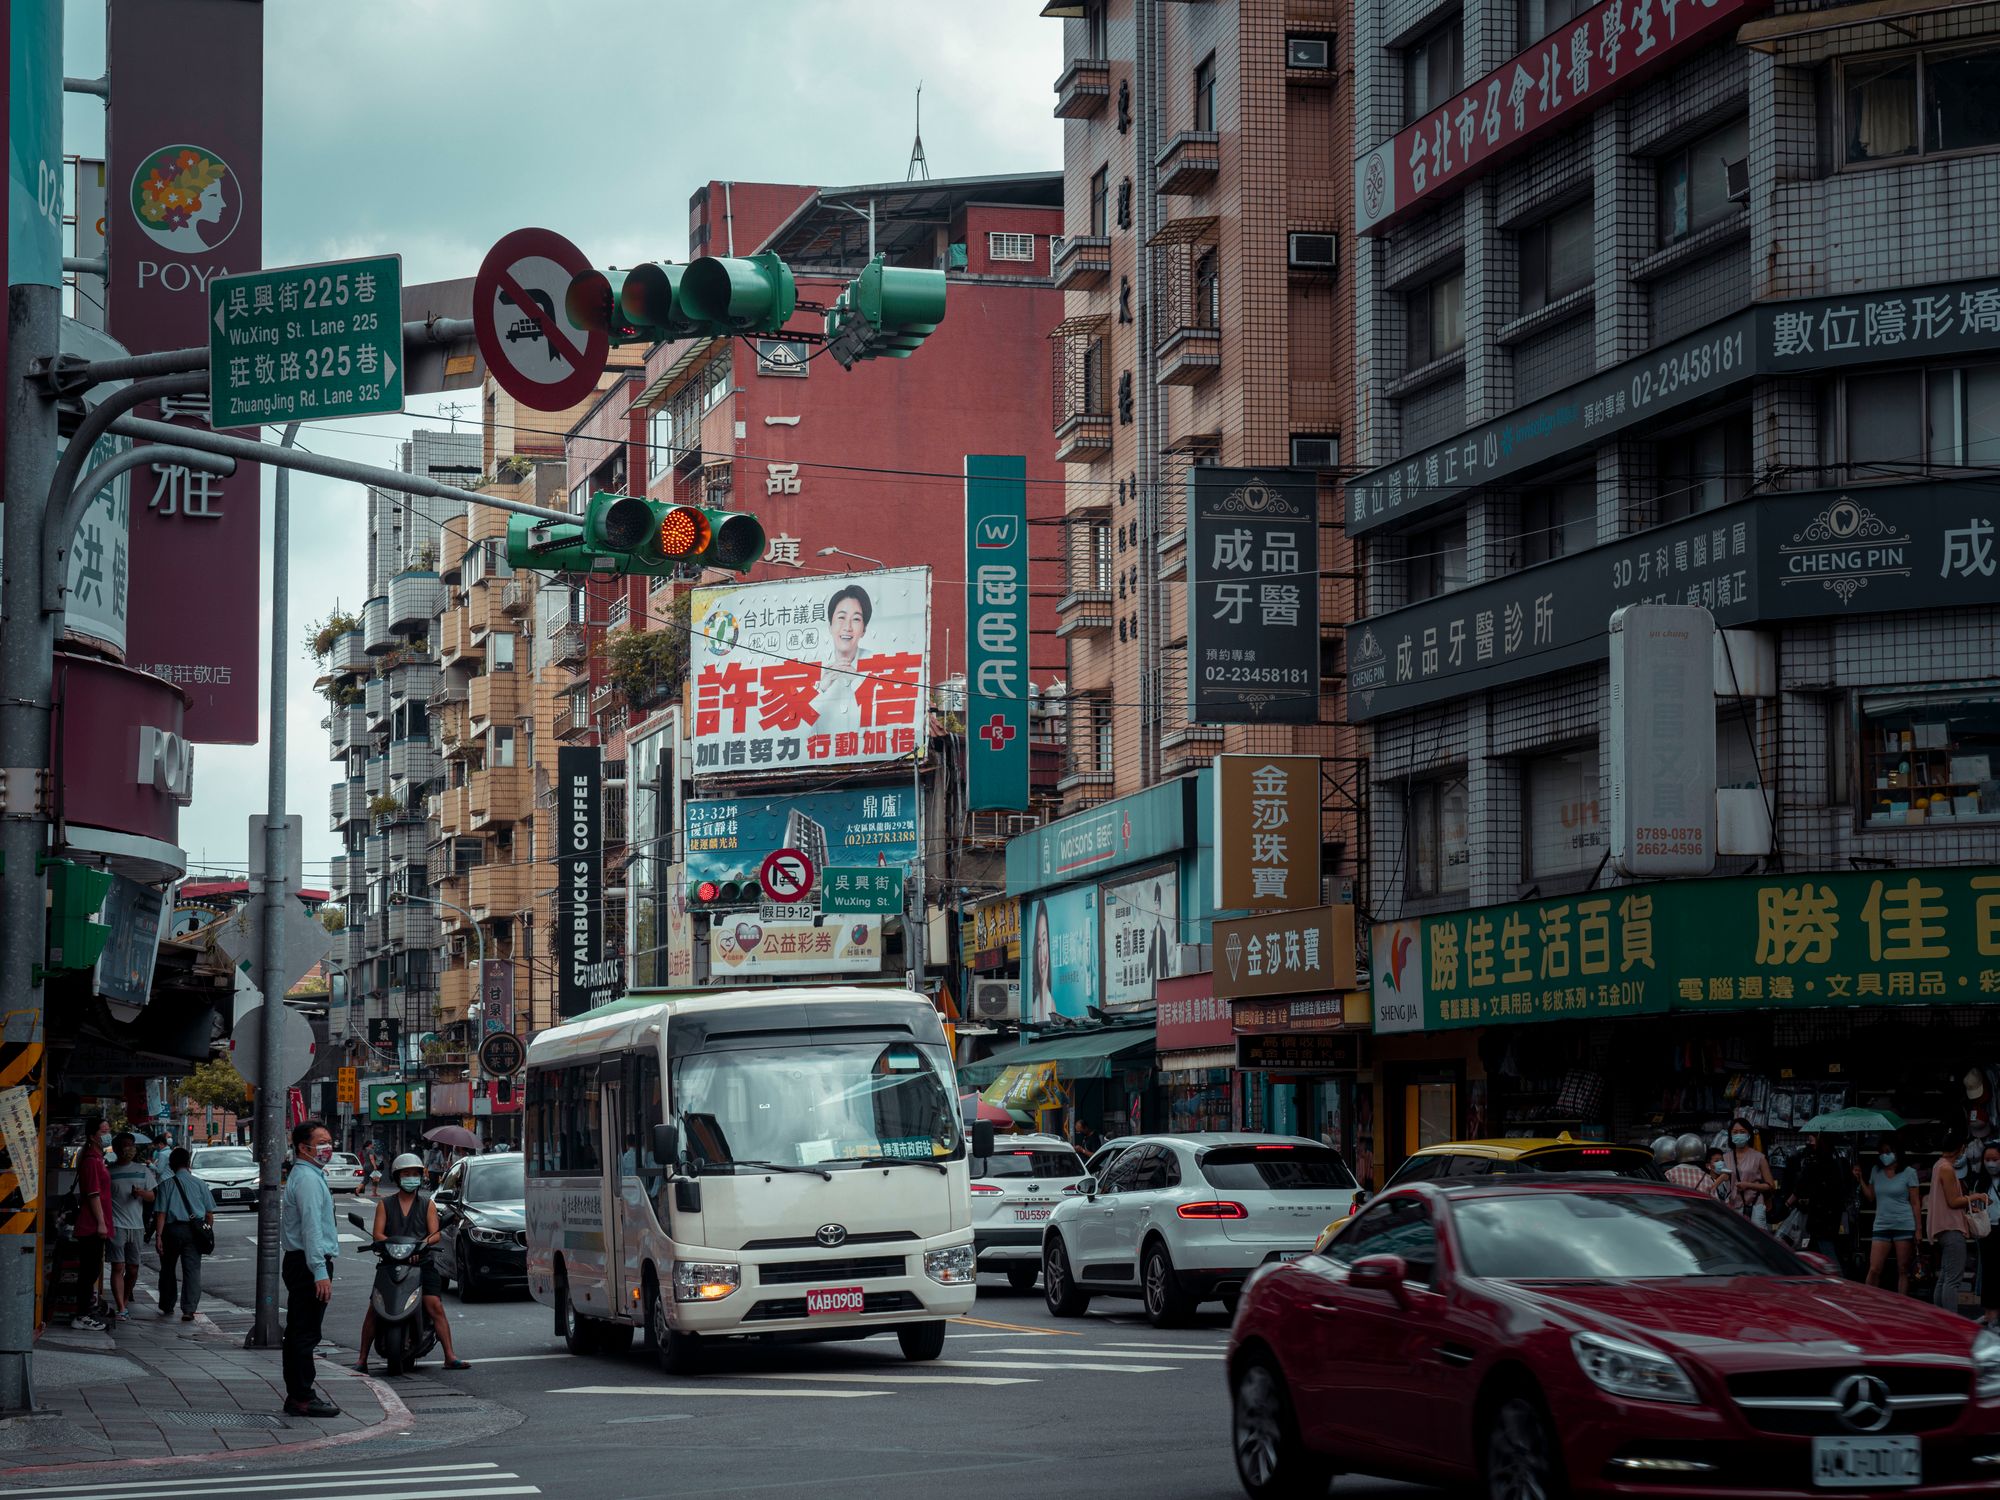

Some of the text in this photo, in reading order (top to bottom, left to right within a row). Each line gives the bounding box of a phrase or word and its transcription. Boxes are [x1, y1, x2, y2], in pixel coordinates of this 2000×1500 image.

[37, 158, 63, 226] 02-
[228, 271, 377, 320] 吳興街225巷
[229, 312, 378, 346] WuXing St. Lane 225
[229, 343, 379, 389] 莊敬路325巷
[1583, 331, 1744, 429] 預約專線 02-23458181
[230, 384, 381, 415] ZhuangJing Rd. Lane 325
[764, 415, 805, 567] 一品庭
[1353, 430, 1499, 522] 數位隱形矯正中心
[1788, 548, 1903, 573] CHENG PIN
[1940, 518, 1997, 580] 成
[743, 603, 827, 629] 台北市議員
[752, 632, 817, 650] 松山 信義
[977, 564, 1017, 700] 屈臣氏
[1396, 592, 1554, 682] 成品牙醫診所
[1206, 648, 1256, 662] 預約專線
[1205, 667, 1309, 684] 02-23458181
[1352, 667, 1385, 688] CHENG PIN
[696, 728, 916, 767] 加倍努力 行動加倍
[690, 805, 738, 821] 23-32坪
[844, 831, 916, 848] (02)23783388
[1251, 764, 1289, 899] 金莎珠寶
[1636, 827, 1703, 841] 8789-0878
[1636, 842, 1703, 855] 2662-4596
[574, 775, 588, 987] STARBUCKS COFFEE
[835, 875, 890, 892] 吳興街
[835, 896, 890, 909] WuXing St.
[763, 932, 832, 955] 公益彩券
[1247, 927, 1320, 976] 金莎珠寶
[1430, 894, 1655, 991] 勝佳生活百貨
[582, 959, 619, 989] STARBUCKS
[1380, 1004, 1418, 1022] SHENG JIA
[808, 1292, 863, 1311] KAB-0908
